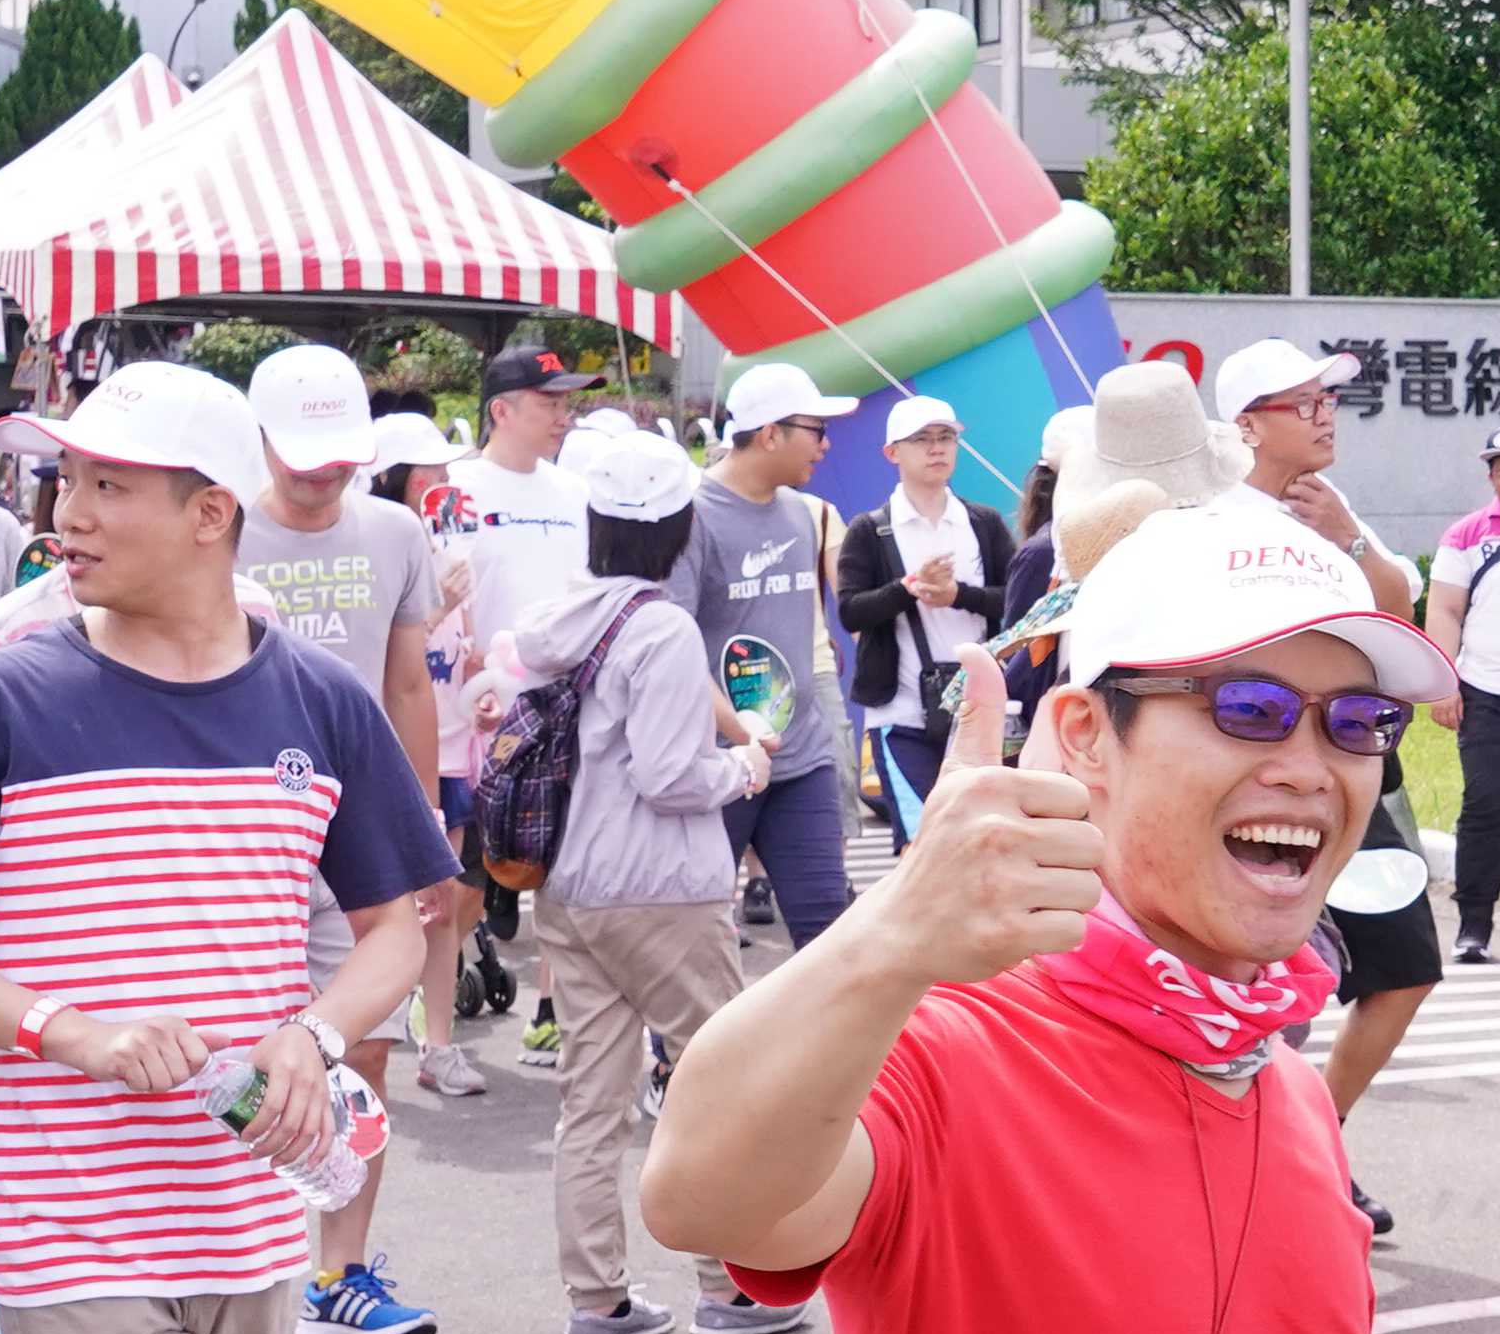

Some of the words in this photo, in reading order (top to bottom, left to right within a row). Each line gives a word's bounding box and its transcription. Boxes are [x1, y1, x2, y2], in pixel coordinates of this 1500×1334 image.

[485, 512, 576, 535] Champion
[1227, 545, 1343, 583] DENSO
[765, 574, 790, 595] FOR
